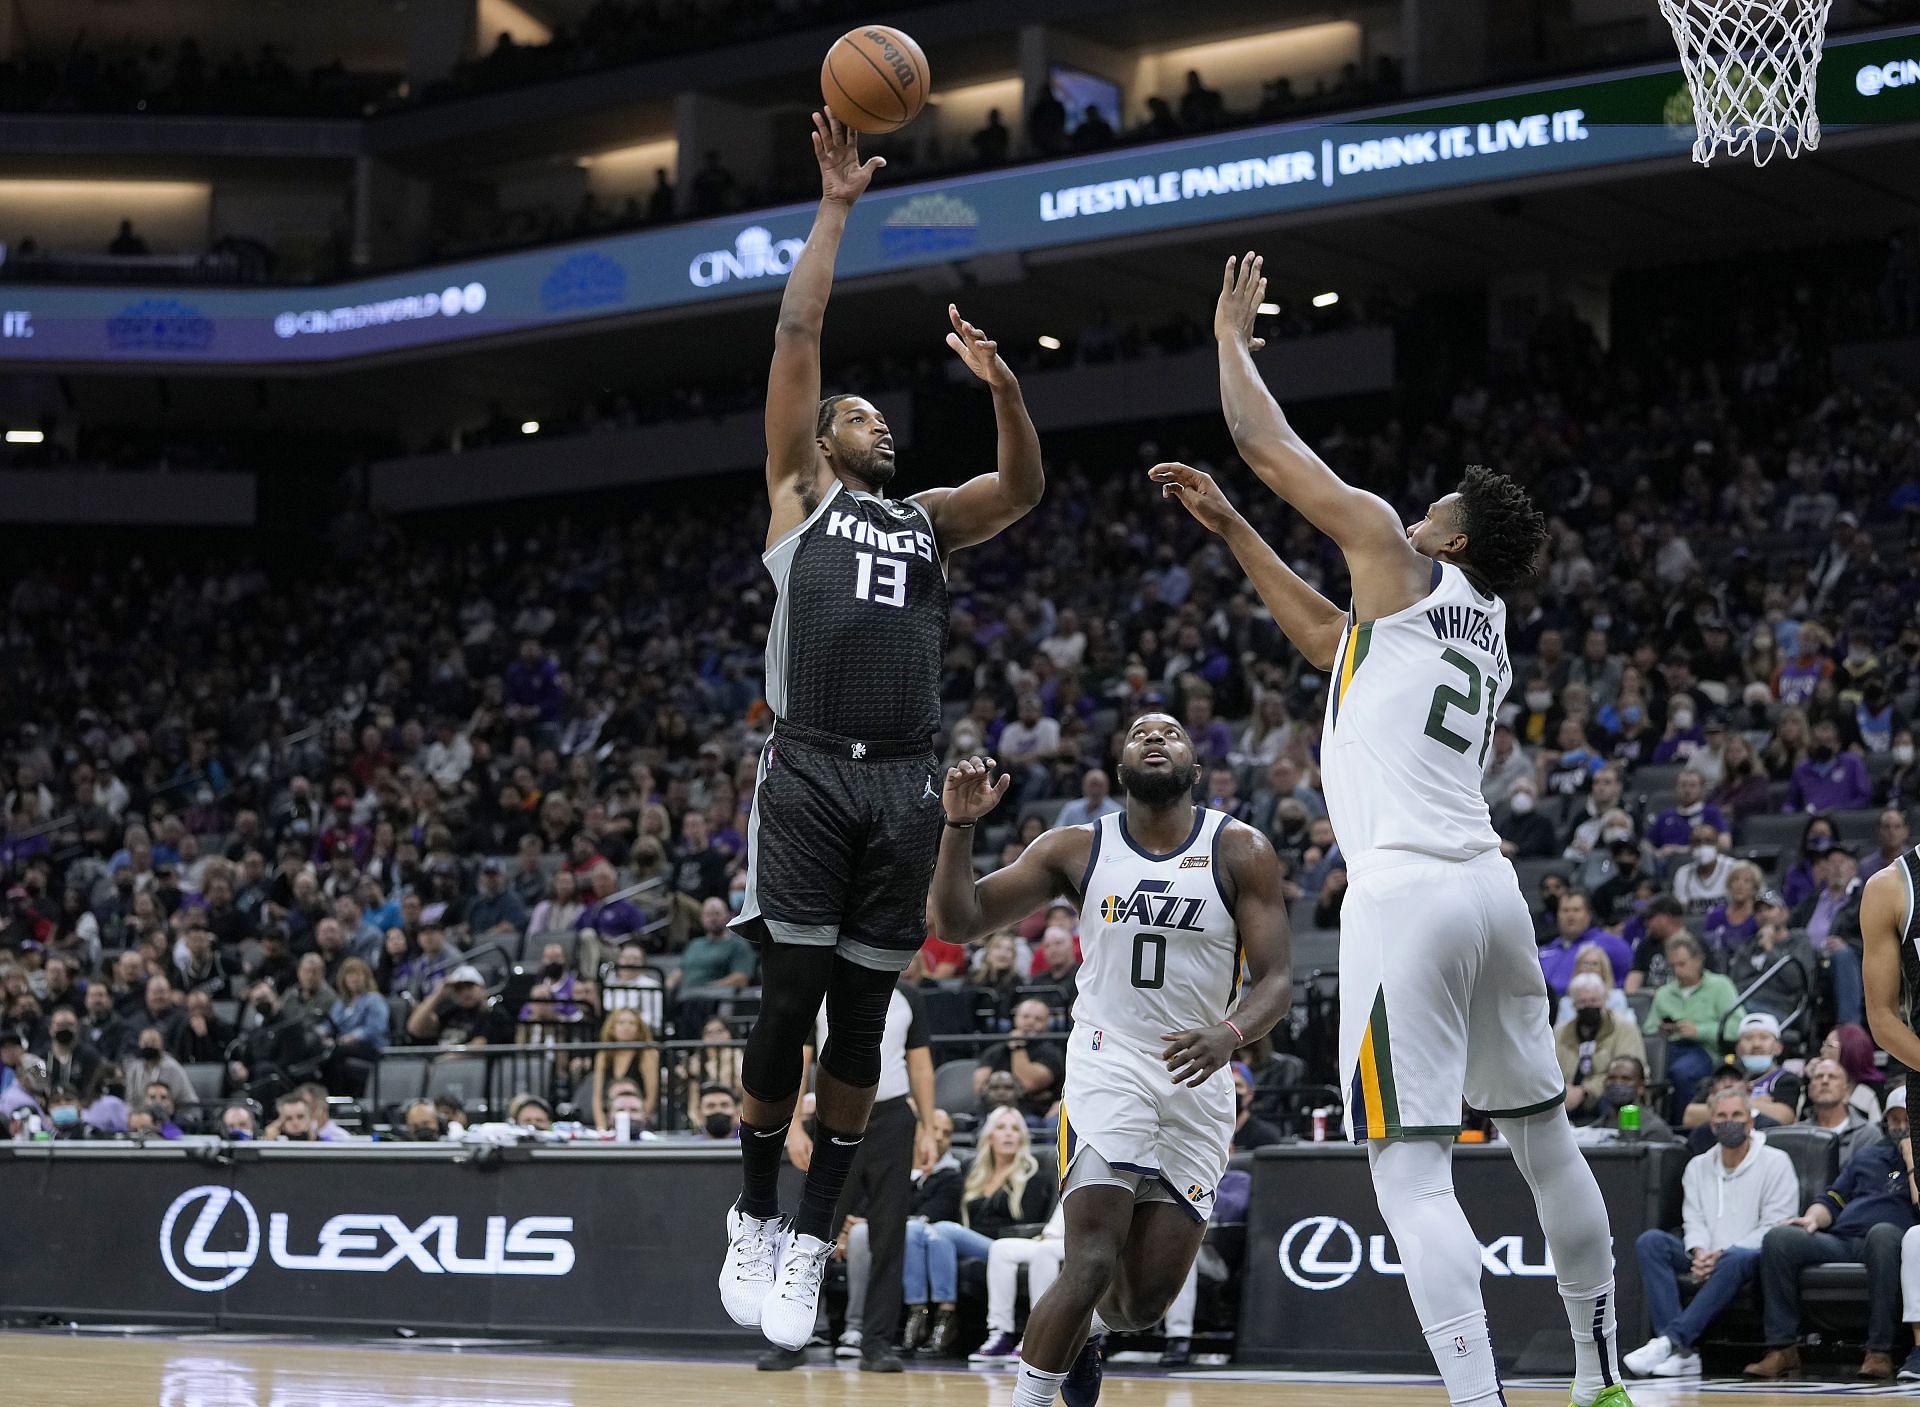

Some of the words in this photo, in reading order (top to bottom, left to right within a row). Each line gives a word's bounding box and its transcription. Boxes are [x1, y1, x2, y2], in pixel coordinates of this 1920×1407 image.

[1040, 171, 1181, 222] LIFESTYLE
[1181, 151, 1315, 199] PARTNER
[1338, 131, 1437, 175] DRINK
[1439, 126, 1475, 160] IT.
[1477, 114, 1549, 154] LIVE
[1552, 109, 1588, 143] IT.
[826, 511, 932, 562] KINGS
[855, 551, 907, 608] 13
[1426, 606, 1509, 682] WHITESIDE
[1424, 647, 1498, 769] 21
[1100, 879, 1207, 932] JAZZ
[1131, 932, 1166, 989] 0
[269, 1213, 576, 1276] LEXUS
[1369, 1234, 1617, 1276] LXU
